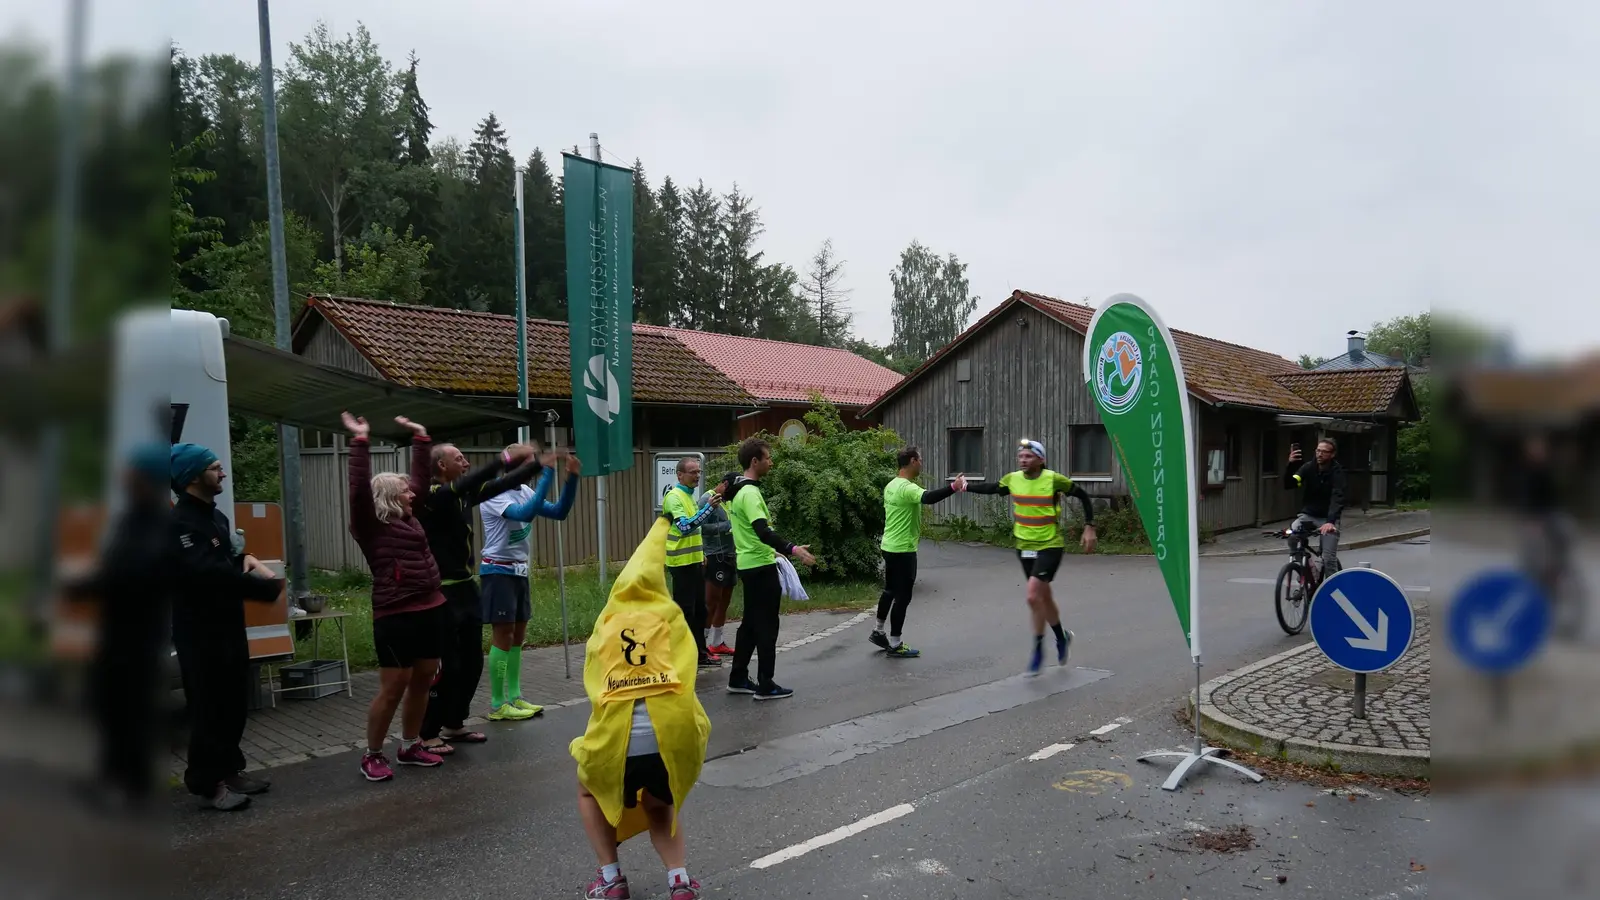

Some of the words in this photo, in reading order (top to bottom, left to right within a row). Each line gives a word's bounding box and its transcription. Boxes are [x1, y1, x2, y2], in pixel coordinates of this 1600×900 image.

[590, 220, 607, 349] BAYERISCHE
[661, 466, 676, 475] Betri
[607, 675, 651, 691] Neunkirchen
[660, 672, 671, 683] Br.
